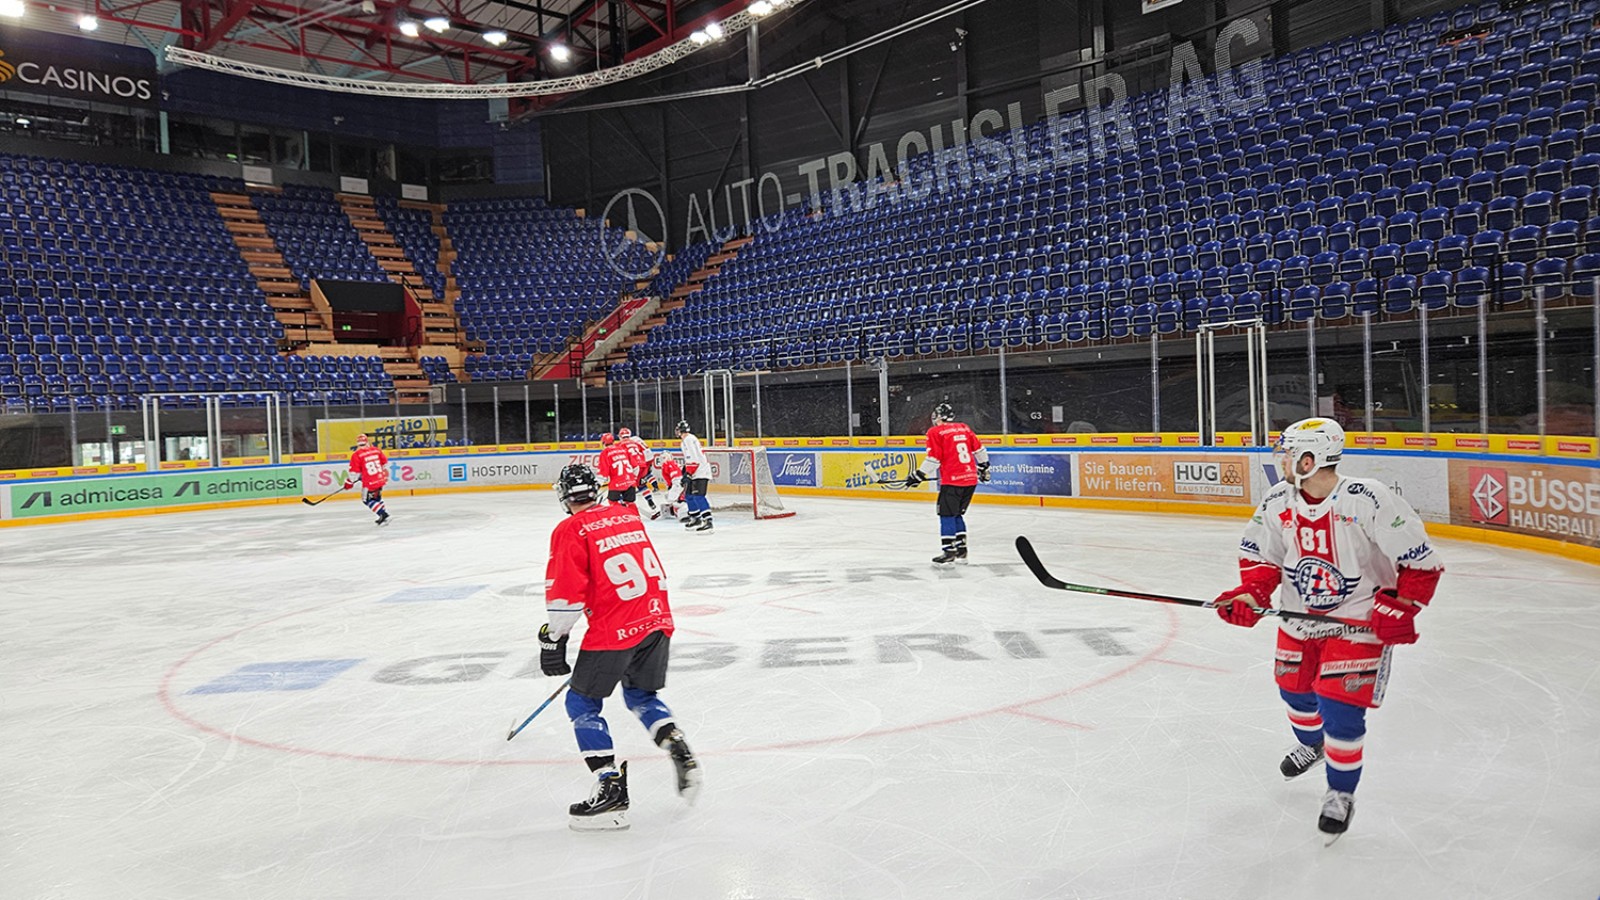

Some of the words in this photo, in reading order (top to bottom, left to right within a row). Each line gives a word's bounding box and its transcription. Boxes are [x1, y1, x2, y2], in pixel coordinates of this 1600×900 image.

[16, 62, 152, 100] CASINOS
[1167, 17, 1267, 135] AG
[956, 442, 971, 464] 8
[471, 464, 538, 478] HOSTPOINT
[1016, 463, 1054, 474] Vitamine
[1085, 461, 1105, 475] Sie
[1109, 461, 1157, 477] bauen.
[1176, 465, 1219, 481] HUG
[207, 476, 298, 495] admicasa
[1085, 477, 1111, 490] Wir
[1115, 478, 1167, 493] liefern.
[1177, 485, 1225, 494] BAUSTOFFE
[1229, 486, 1241, 494] AG
[60, 486, 163, 506] admicasa
[1300, 526, 1328, 554] 81
[604, 548, 668, 601] 94
[372, 627, 1134, 686] GBERIT
